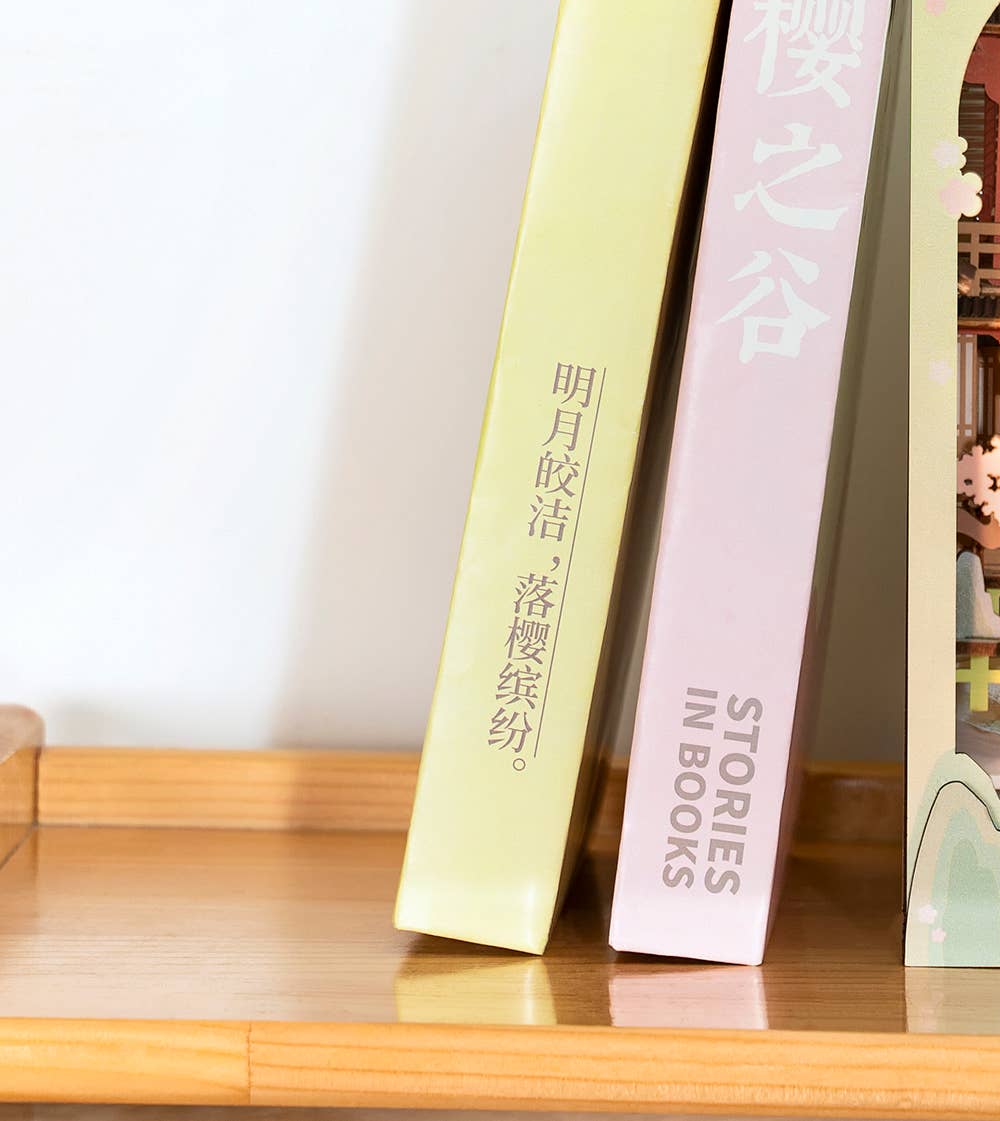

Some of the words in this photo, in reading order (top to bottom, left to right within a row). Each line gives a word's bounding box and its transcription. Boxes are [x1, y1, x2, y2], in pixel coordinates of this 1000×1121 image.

[682, 687, 718, 731] IN
[662, 742, 711, 889] BOOKS
[704, 693, 763, 896] STORIES
